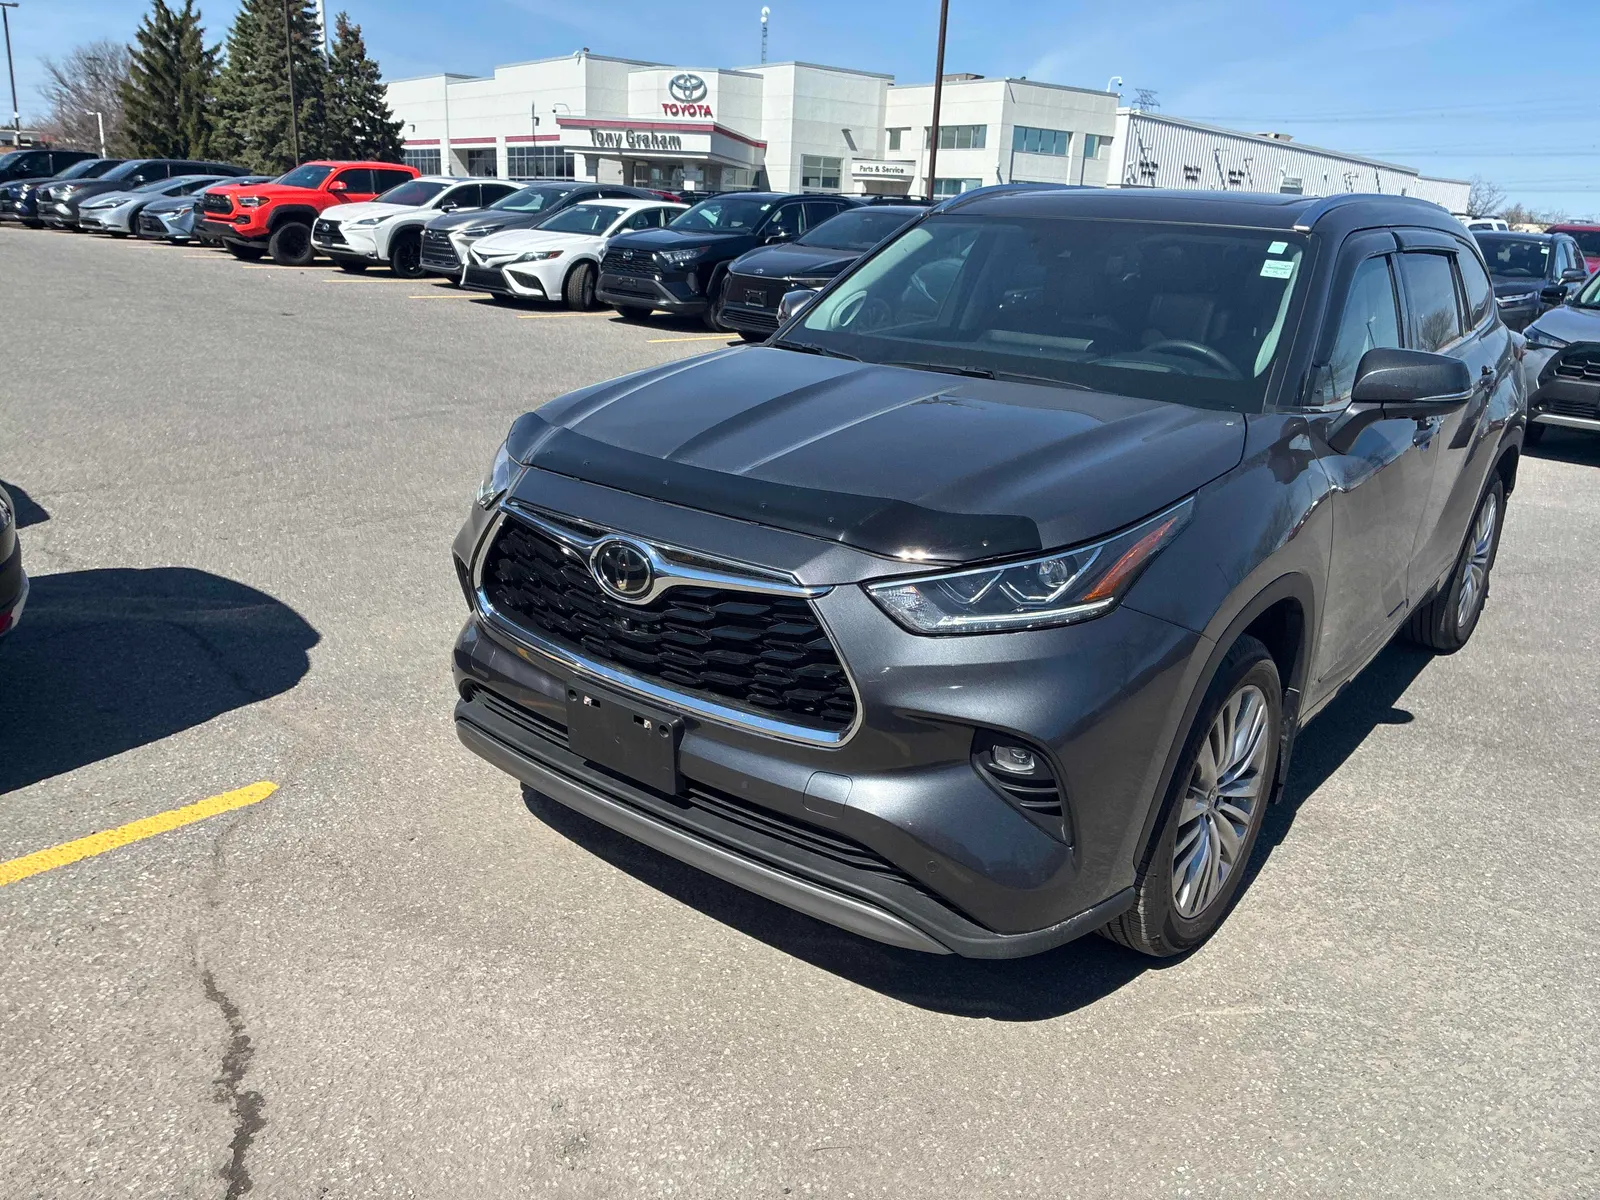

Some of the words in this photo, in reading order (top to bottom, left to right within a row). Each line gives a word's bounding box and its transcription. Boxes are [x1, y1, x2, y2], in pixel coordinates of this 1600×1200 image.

[661, 103, 713, 118] TOYOTA
[589, 128, 623, 148] Tony
[626, 129, 682, 150] Graham
[860, 165, 873, 173] Parts
[882, 166, 904, 174] Service
